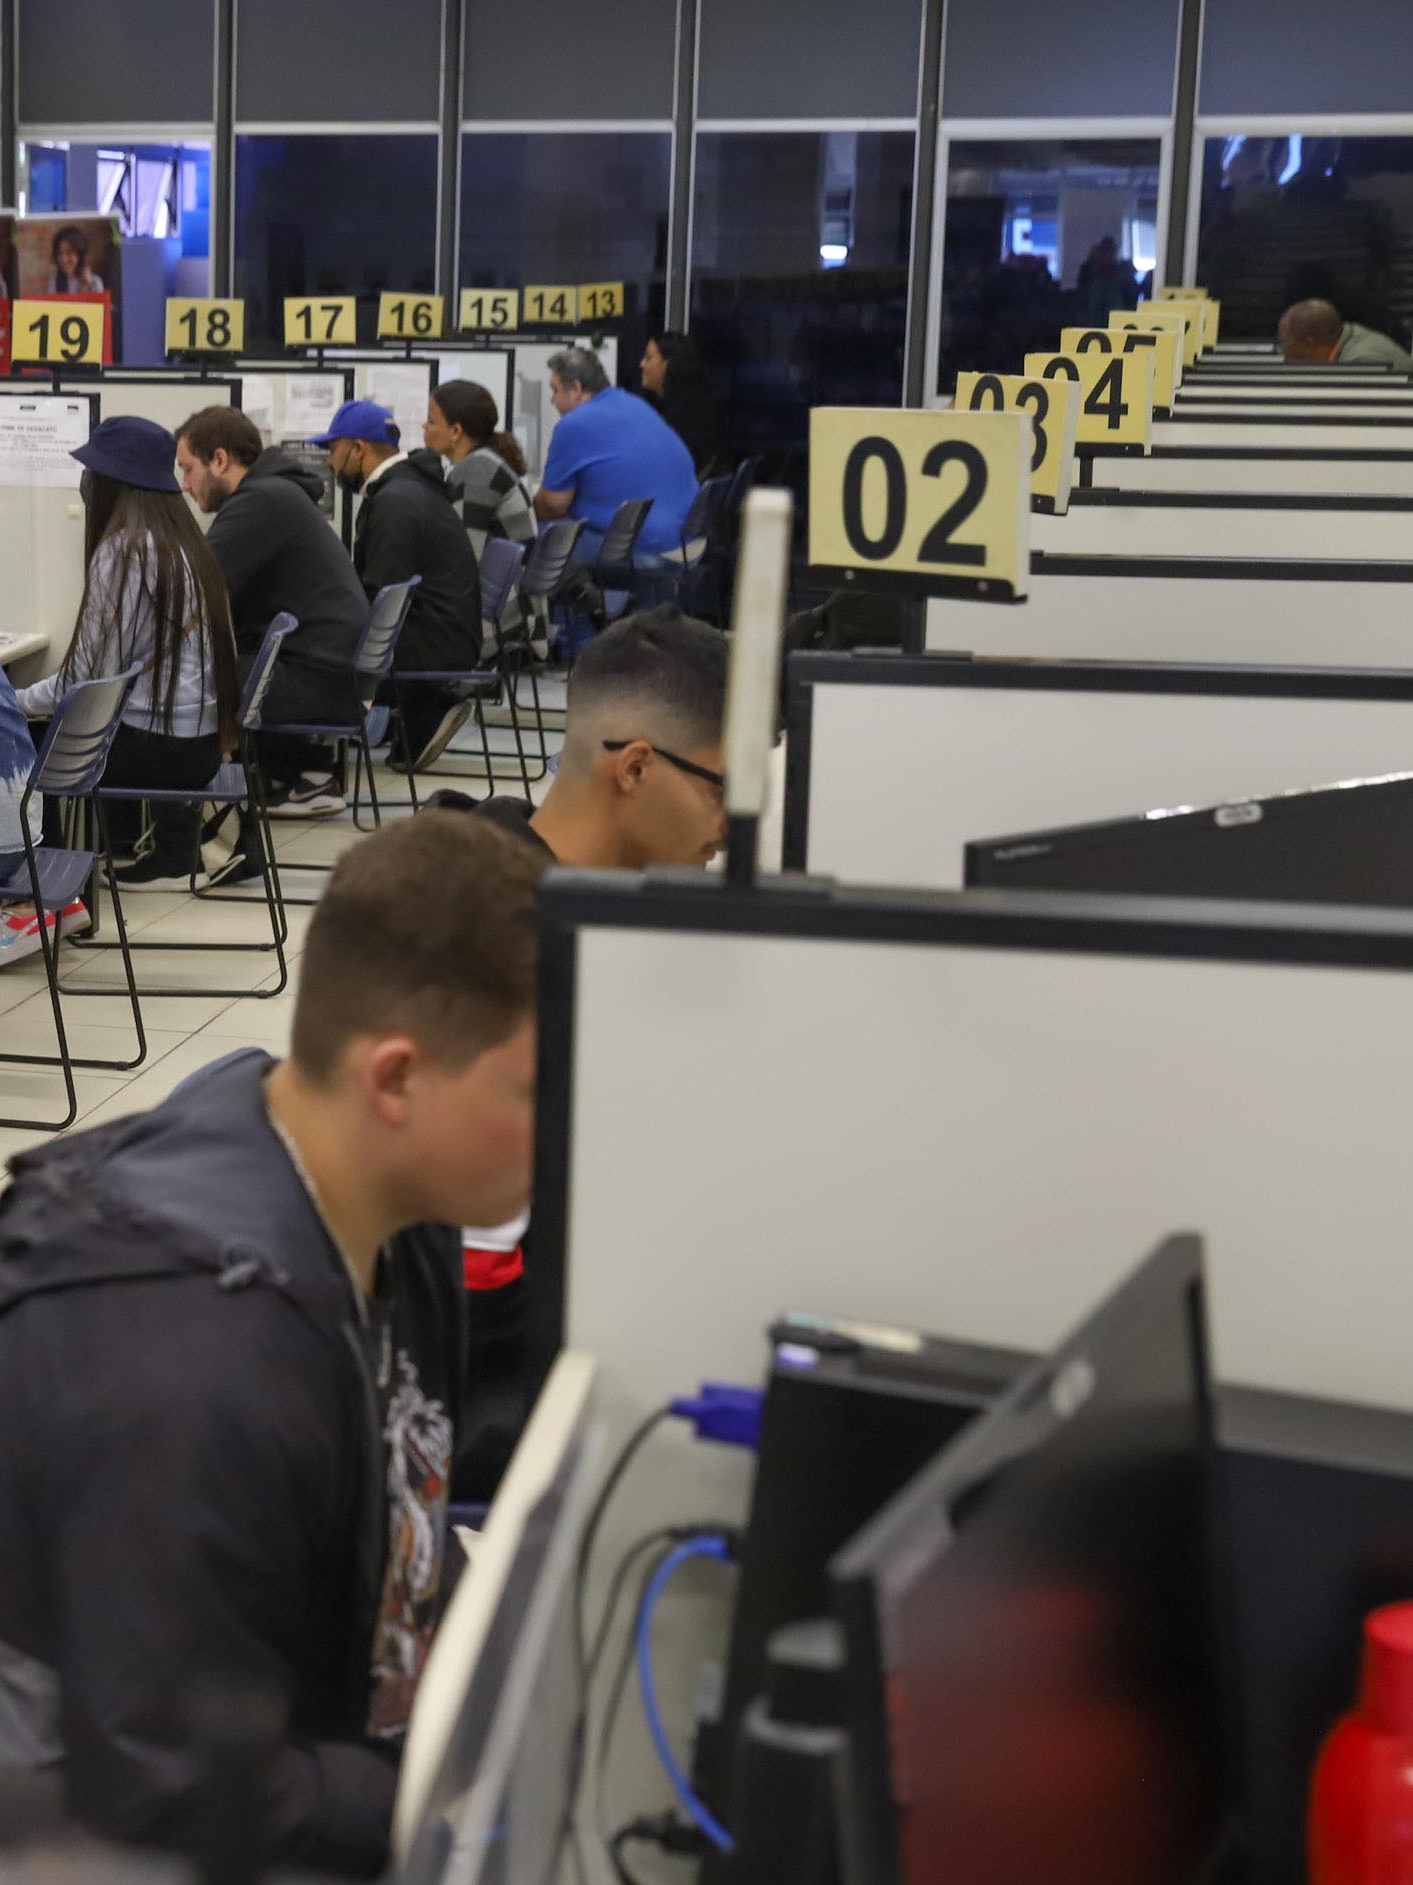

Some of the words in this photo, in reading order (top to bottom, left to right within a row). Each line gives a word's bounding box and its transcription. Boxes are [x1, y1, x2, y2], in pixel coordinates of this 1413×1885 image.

[390, 301, 433, 334] 16
[470, 297, 508, 328] 15
[532, 292, 567, 320] 14
[586, 290, 616, 317] 13
[28, 313, 90, 364] 19
[179, 307, 231, 348] 18
[295, 304, 343, 340] 17
[842, 435, 989, 567] 02
